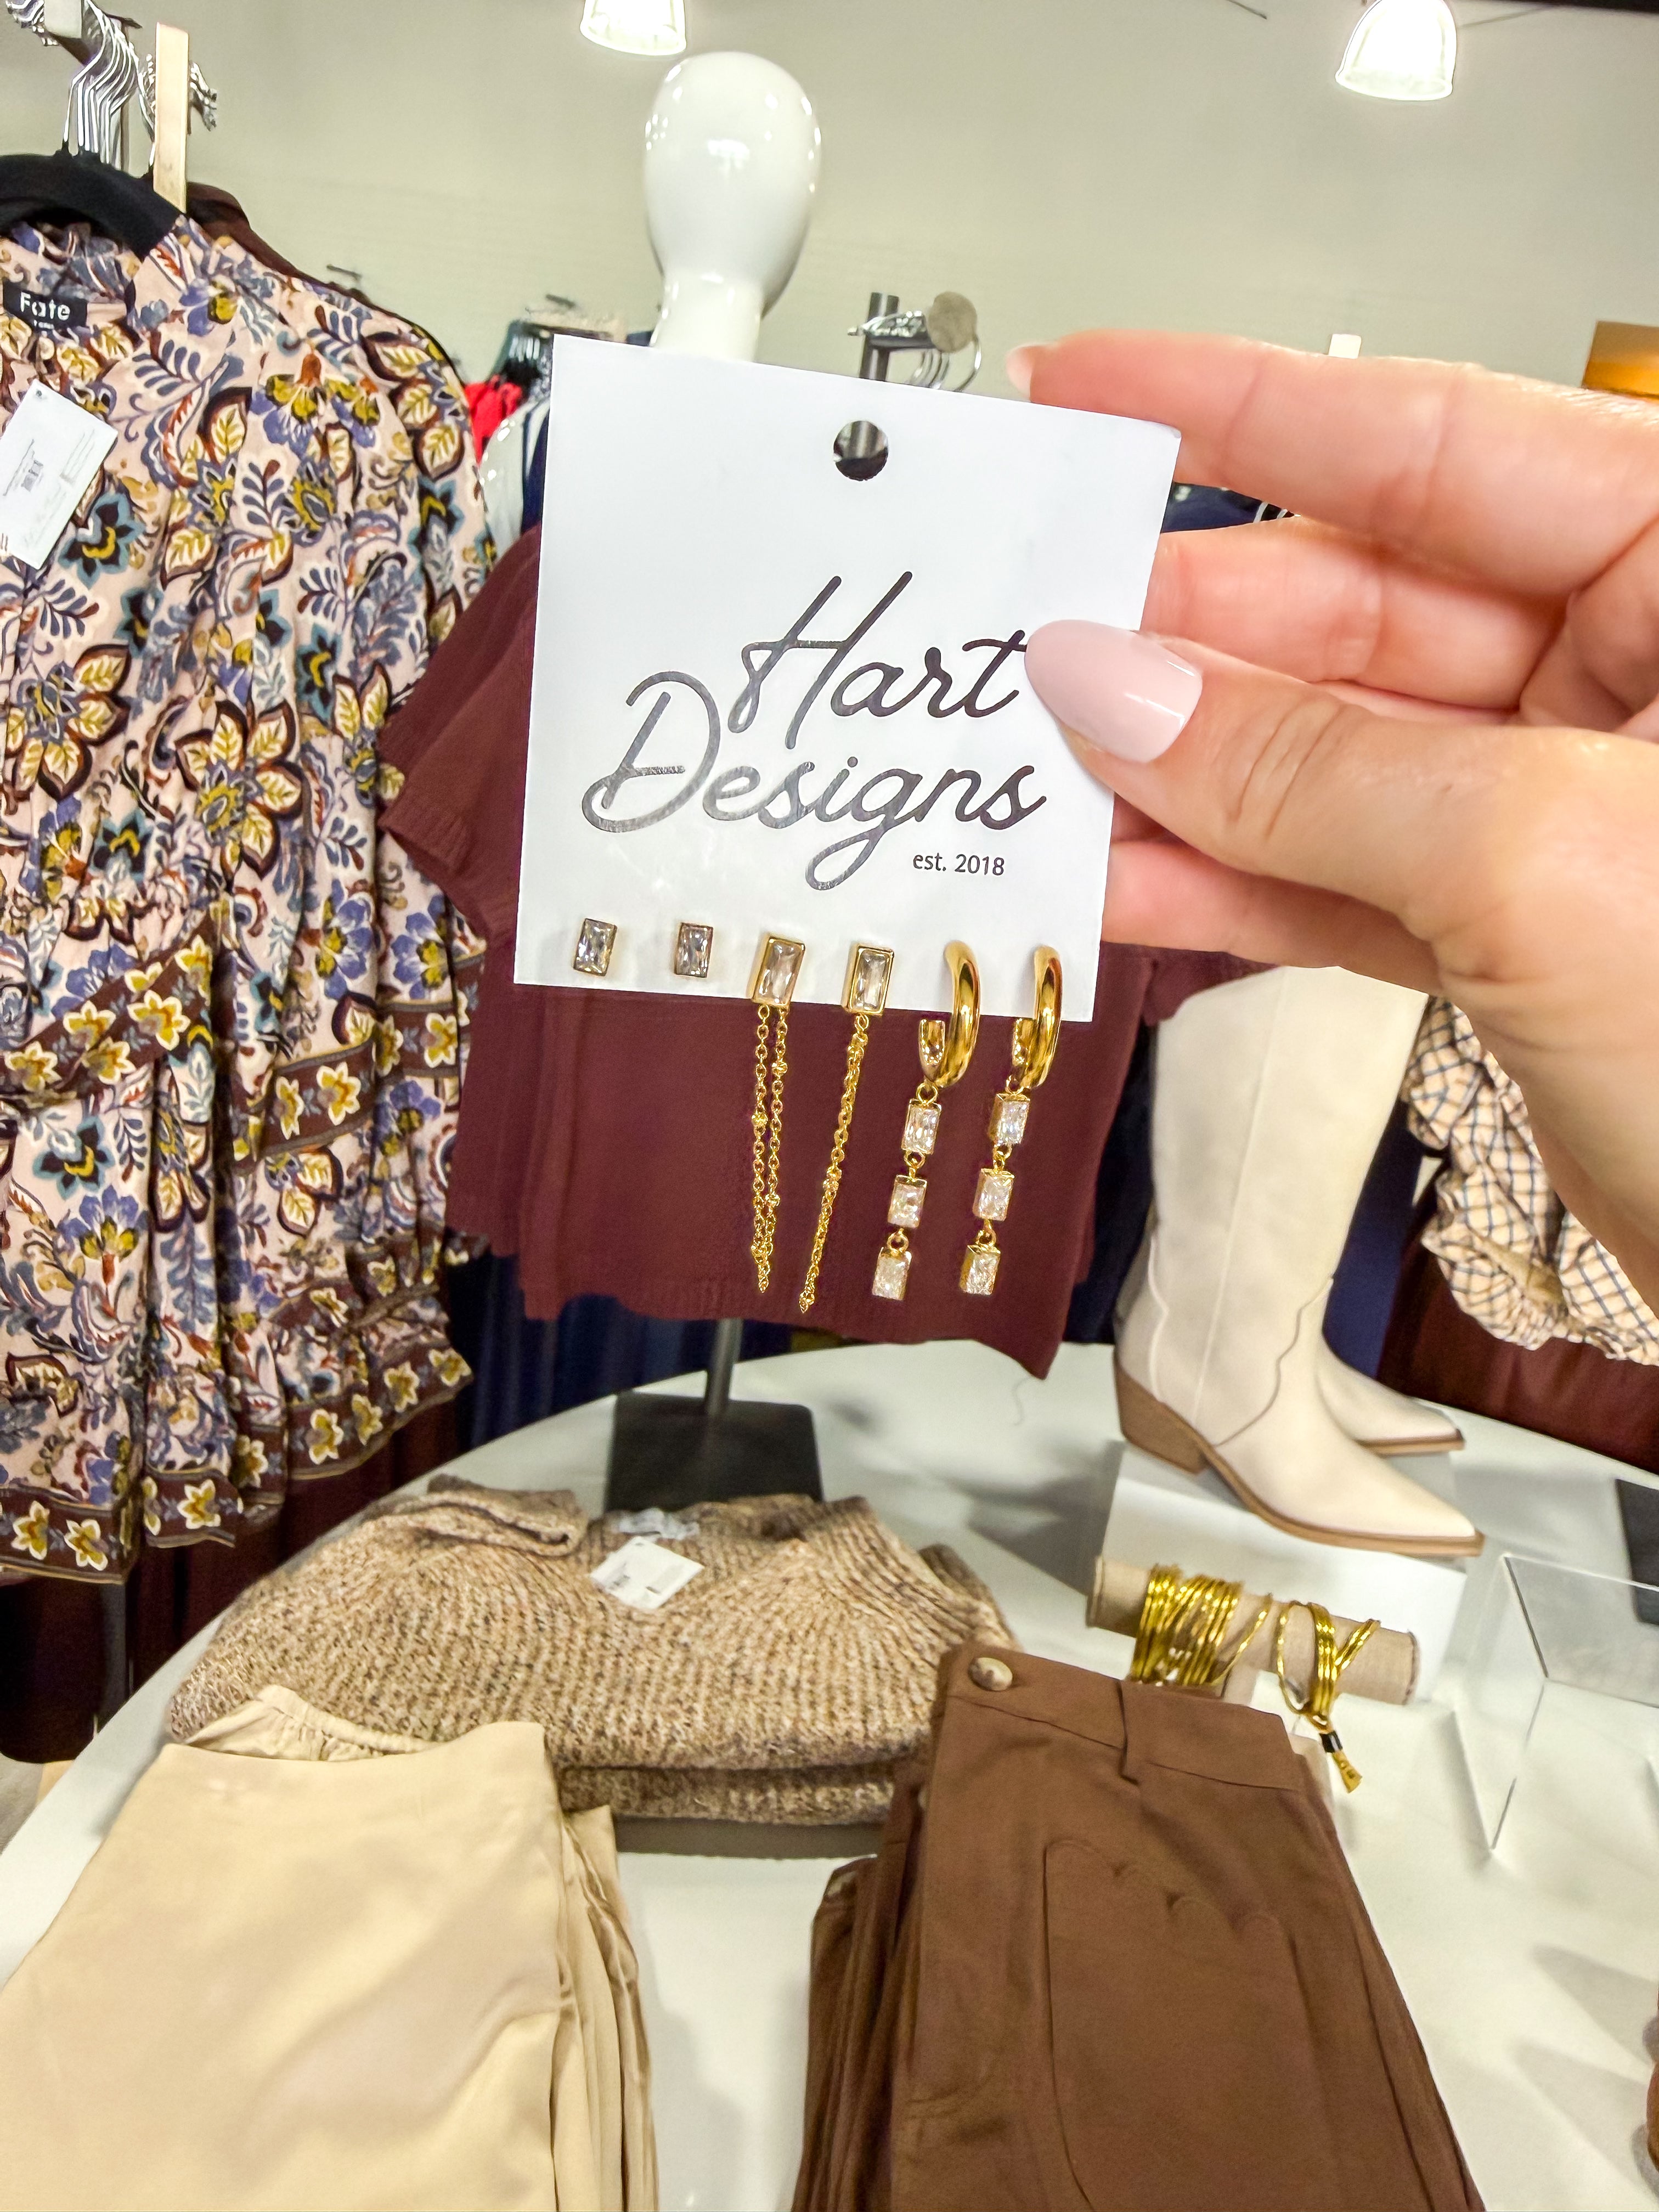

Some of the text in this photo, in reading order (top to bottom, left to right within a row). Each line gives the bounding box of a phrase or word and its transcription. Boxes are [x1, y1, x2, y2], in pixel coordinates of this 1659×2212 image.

[20, 291, 71, 321] Fate
[727, 571, 1028, 750] Hart
[582, 671, 1047, 890] Designs
[913, 853, 1005, 876] est. 2018
